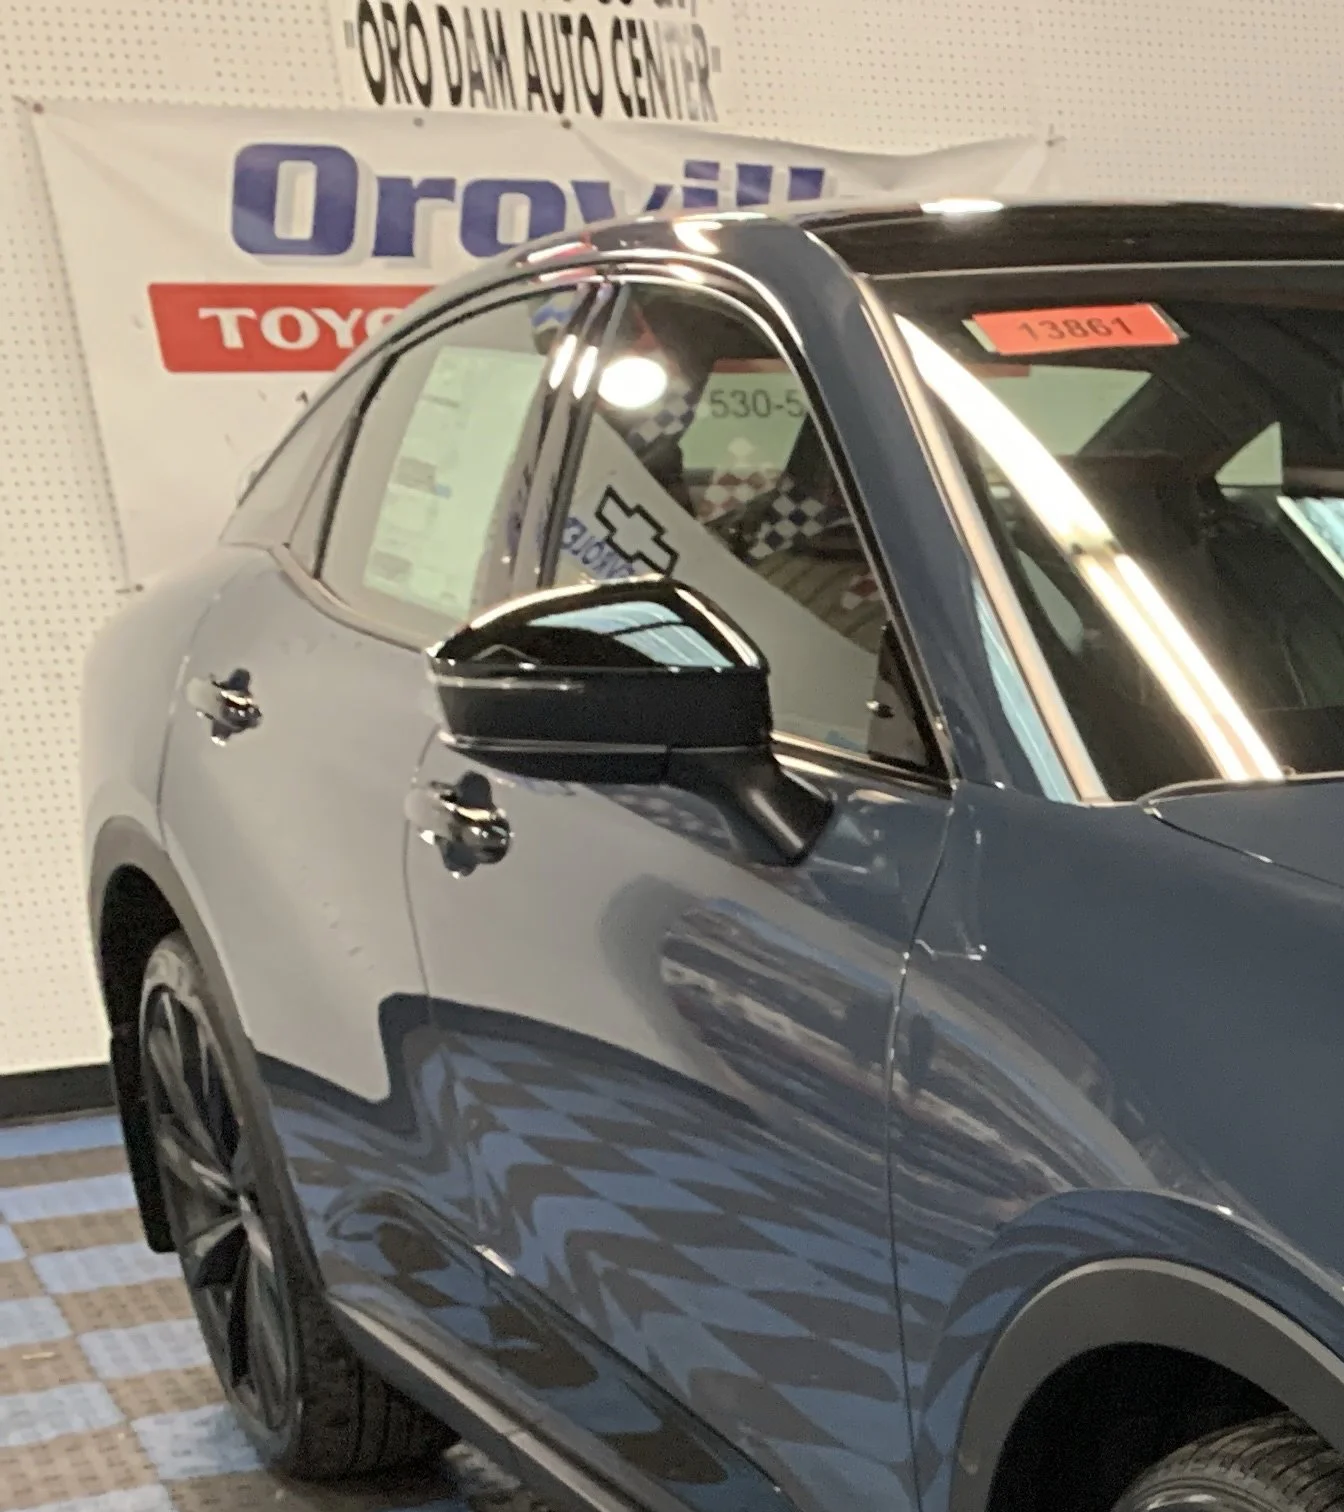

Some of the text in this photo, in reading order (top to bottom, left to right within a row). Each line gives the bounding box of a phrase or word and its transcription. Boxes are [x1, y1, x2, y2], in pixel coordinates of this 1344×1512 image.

[436, 4, 516, 110] DAM
[522, 10, 604, 118] AUTO
[1018, 316, 1134, 342] 13861
